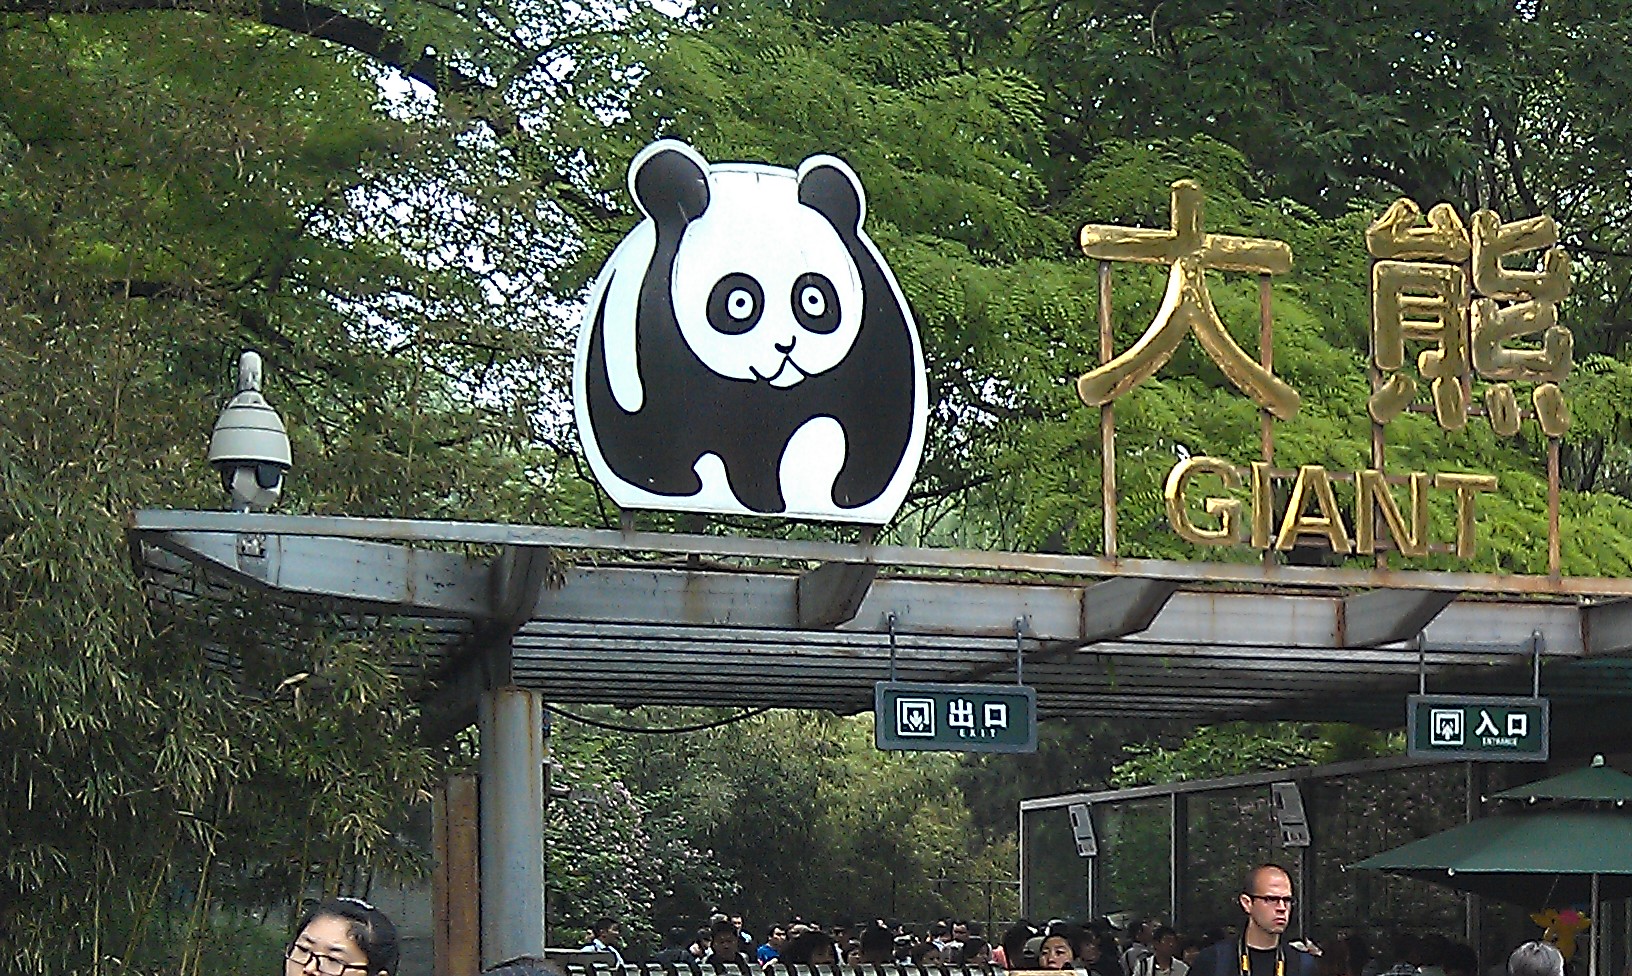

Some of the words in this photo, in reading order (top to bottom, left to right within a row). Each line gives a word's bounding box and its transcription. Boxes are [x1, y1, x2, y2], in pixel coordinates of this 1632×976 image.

[1163, 455, 1498, 561] GIANT
[949, 698, 1007, 728] 出口
[1475, 710, 1527, 737] 入口
[959, 729, 997, 738] EXIT
[1482, 737, 1518, 746] ENTRANCE
